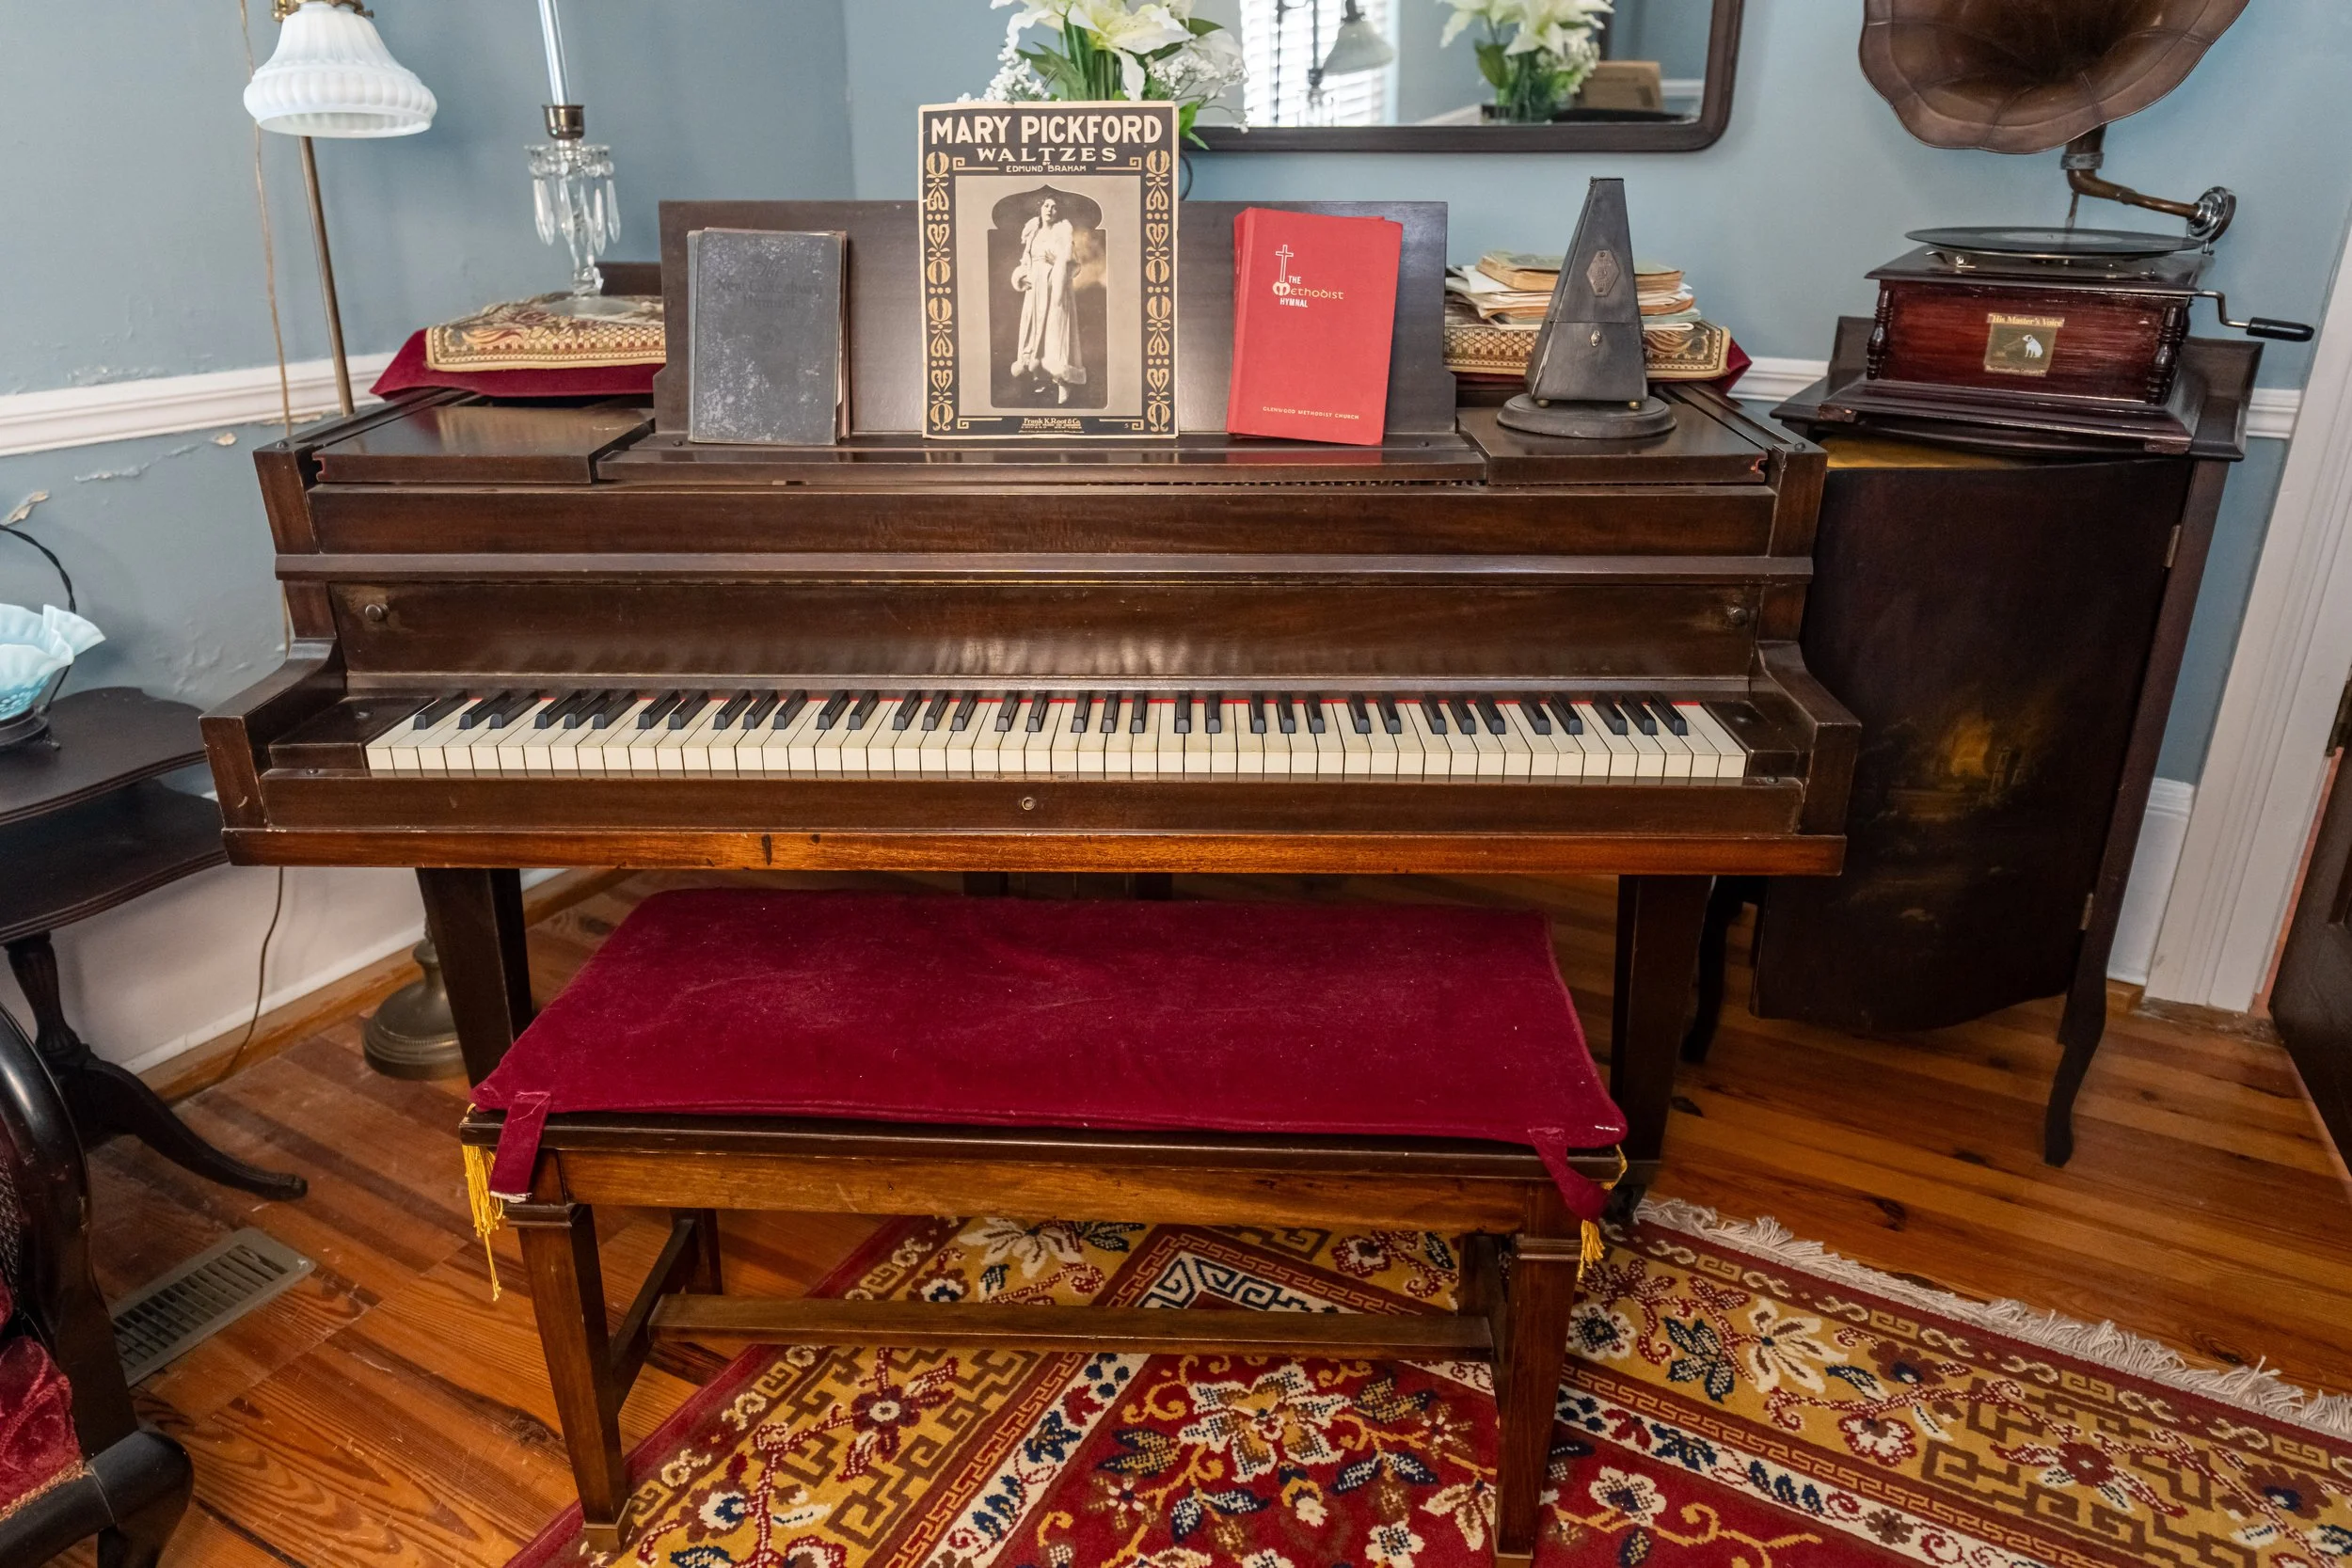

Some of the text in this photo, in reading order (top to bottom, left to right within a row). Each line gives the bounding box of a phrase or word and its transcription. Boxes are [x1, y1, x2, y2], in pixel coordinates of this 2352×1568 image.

[930, 115, 1163, 144] MARY PICKFORD
[977, 147, 1118, 162] WALTZES
[1288, 276, 1301, 284] THE
[1279, 297, 1309, 308] HYMNAL
